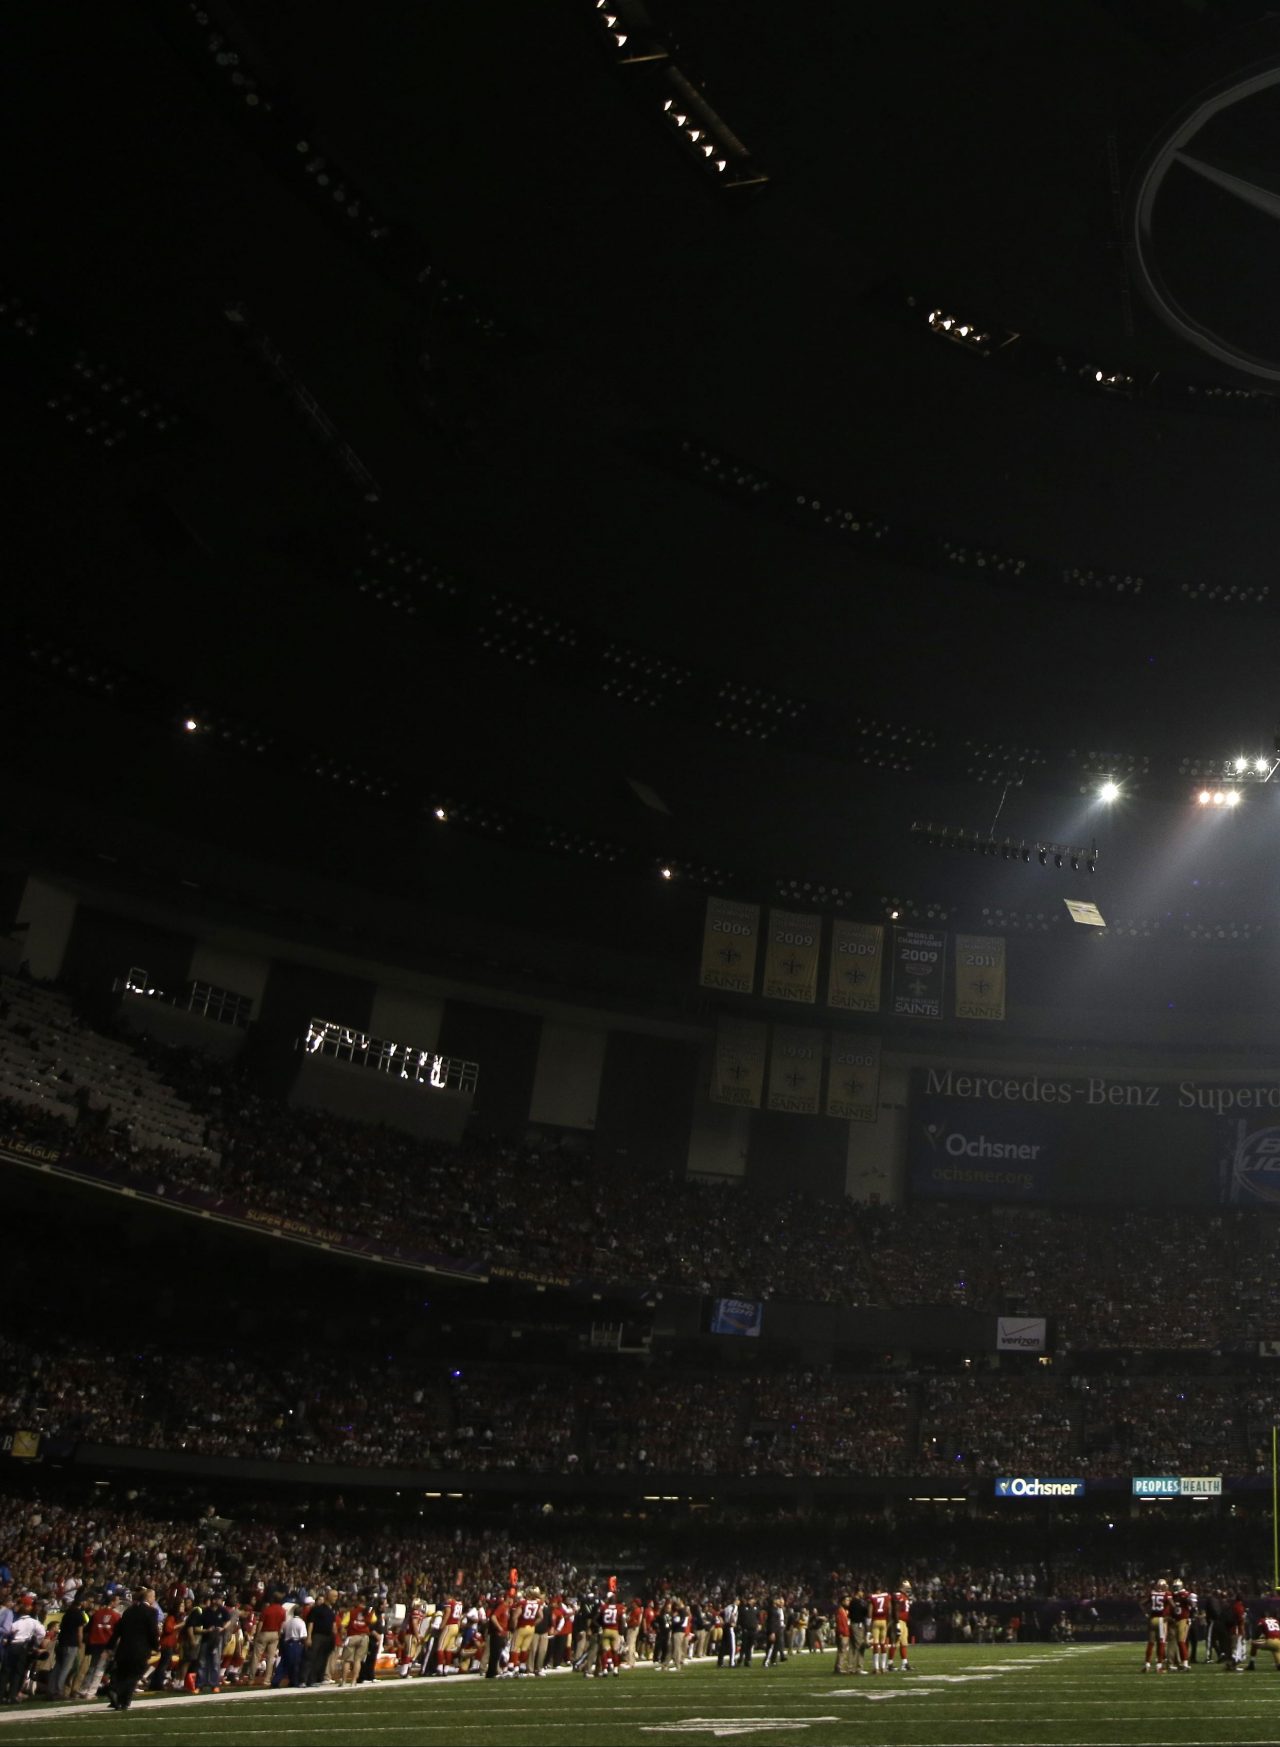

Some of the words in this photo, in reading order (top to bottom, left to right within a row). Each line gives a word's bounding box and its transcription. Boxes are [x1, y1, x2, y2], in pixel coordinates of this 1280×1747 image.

[712, 919, 752, 936] 2006
[775, 931, 814, 946] 2009
[838, 942, 877, 956] 2009
[901, 949, 938, 962] 2009
[965, 954, 996, 967] 2011
[703, 974, 750, 991] SAINTS
[767, 984, 813, 1000] SAINTS
[831, 995, 876, 1010] SAINTS
[896, 1001, 939, 1016] SAINTS
[959, 1006, 1002, 1019] SAINTS
[925, 1069, 1160, 1107] Mercedes-Benz
[771, 1095, 817, 1111] SAINTS
[831, 1103, 873, 1120] SAINTS
[8, 1138, 61, 1162] LEAGUE
[945, 1133, 1040, 1160] Ochsner
[932, 1166, 1033, 1189] ochsner.org
[490, 1266, 514, 1278] NEW
[518, 1271, 570, 1287] ORLEANS
[1001, 1336, 1040, 1346] verizon
[1011, 1478, 1078, 1496] Ochsner
[1136, 1479, 1180, 1493] PEOPLES
[1183, 1479, 1220, 1492] HEALTH
[876, 1596, 885, 1612] 7
[1151, 1595, 1164, 1611] 15
[603, 1608, 618, 1624] 21
